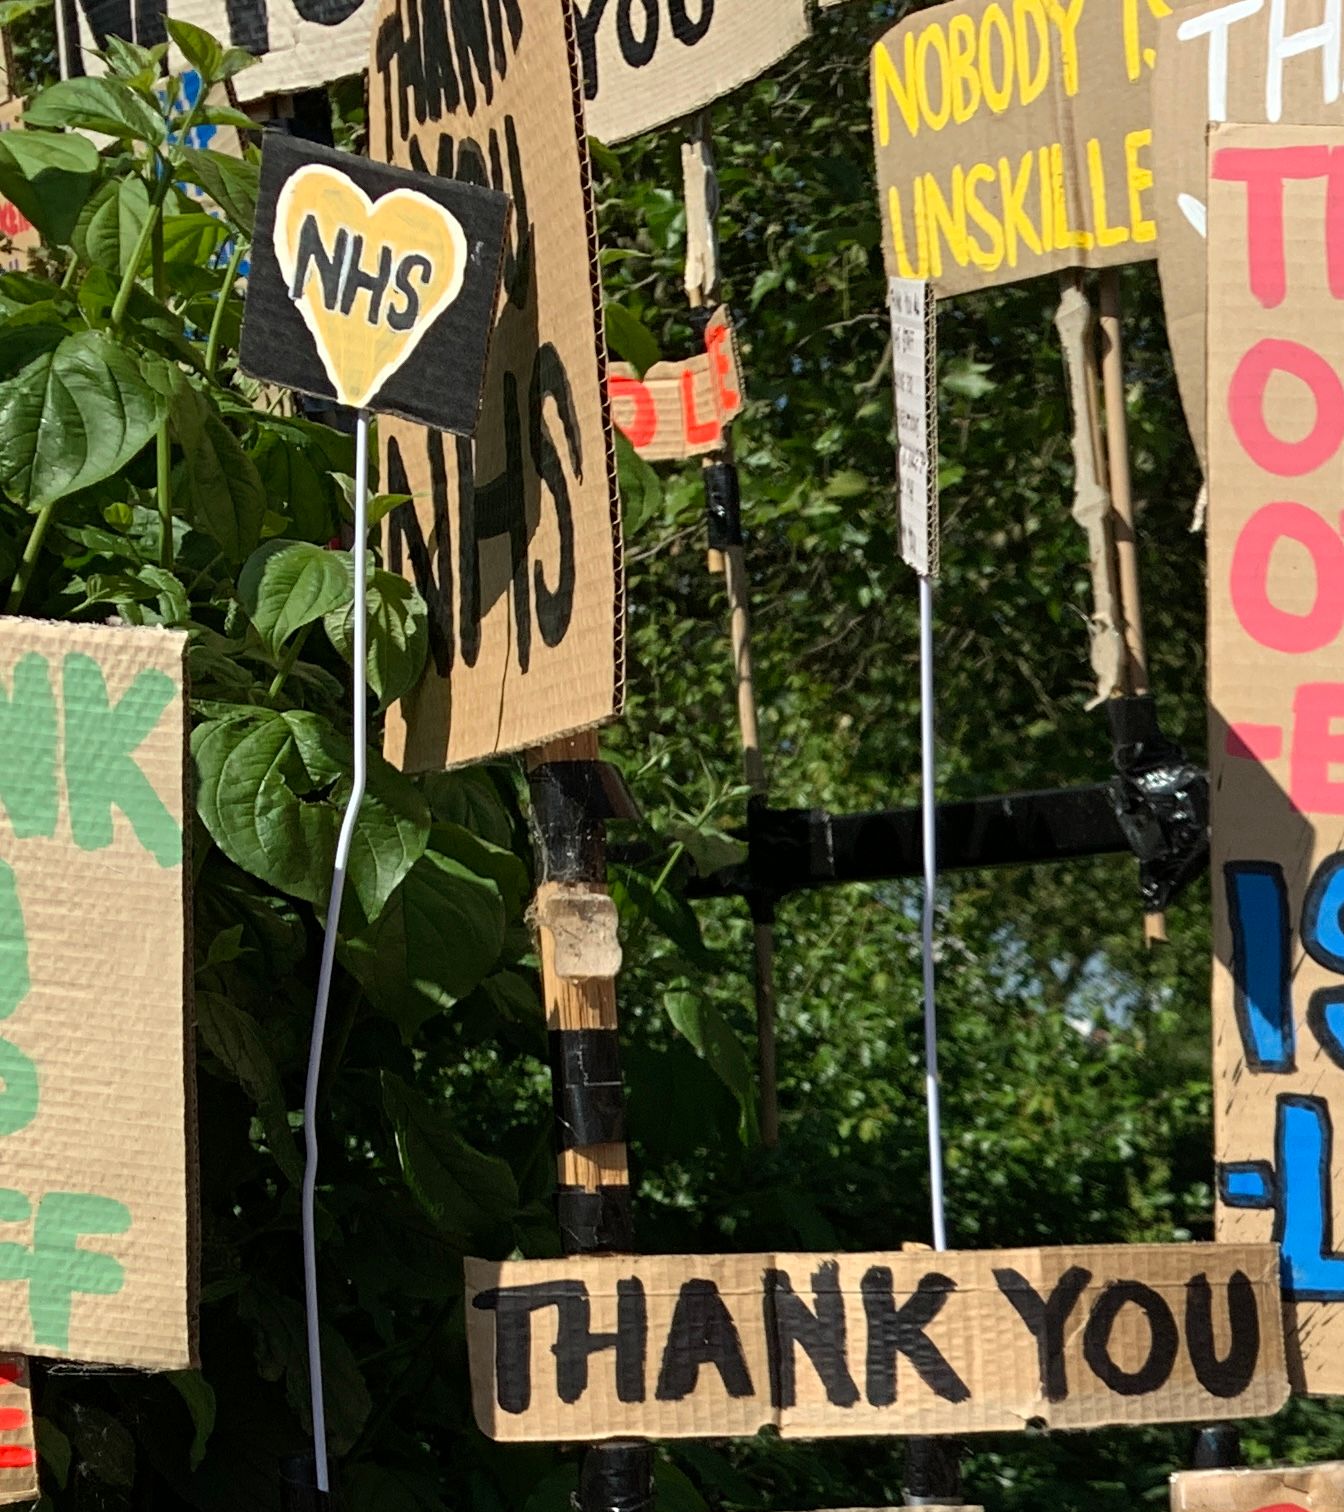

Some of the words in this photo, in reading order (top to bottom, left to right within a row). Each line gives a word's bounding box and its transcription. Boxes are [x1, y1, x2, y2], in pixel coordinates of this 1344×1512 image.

[871, 0, 1080, 147] NOBODY
[290, 214, 433, 331] NHS
[387, 343, 584, 679] NHS
[471, 1260, 974, 1416] THANK
[992, 1264, 1261, 1402] YOU
